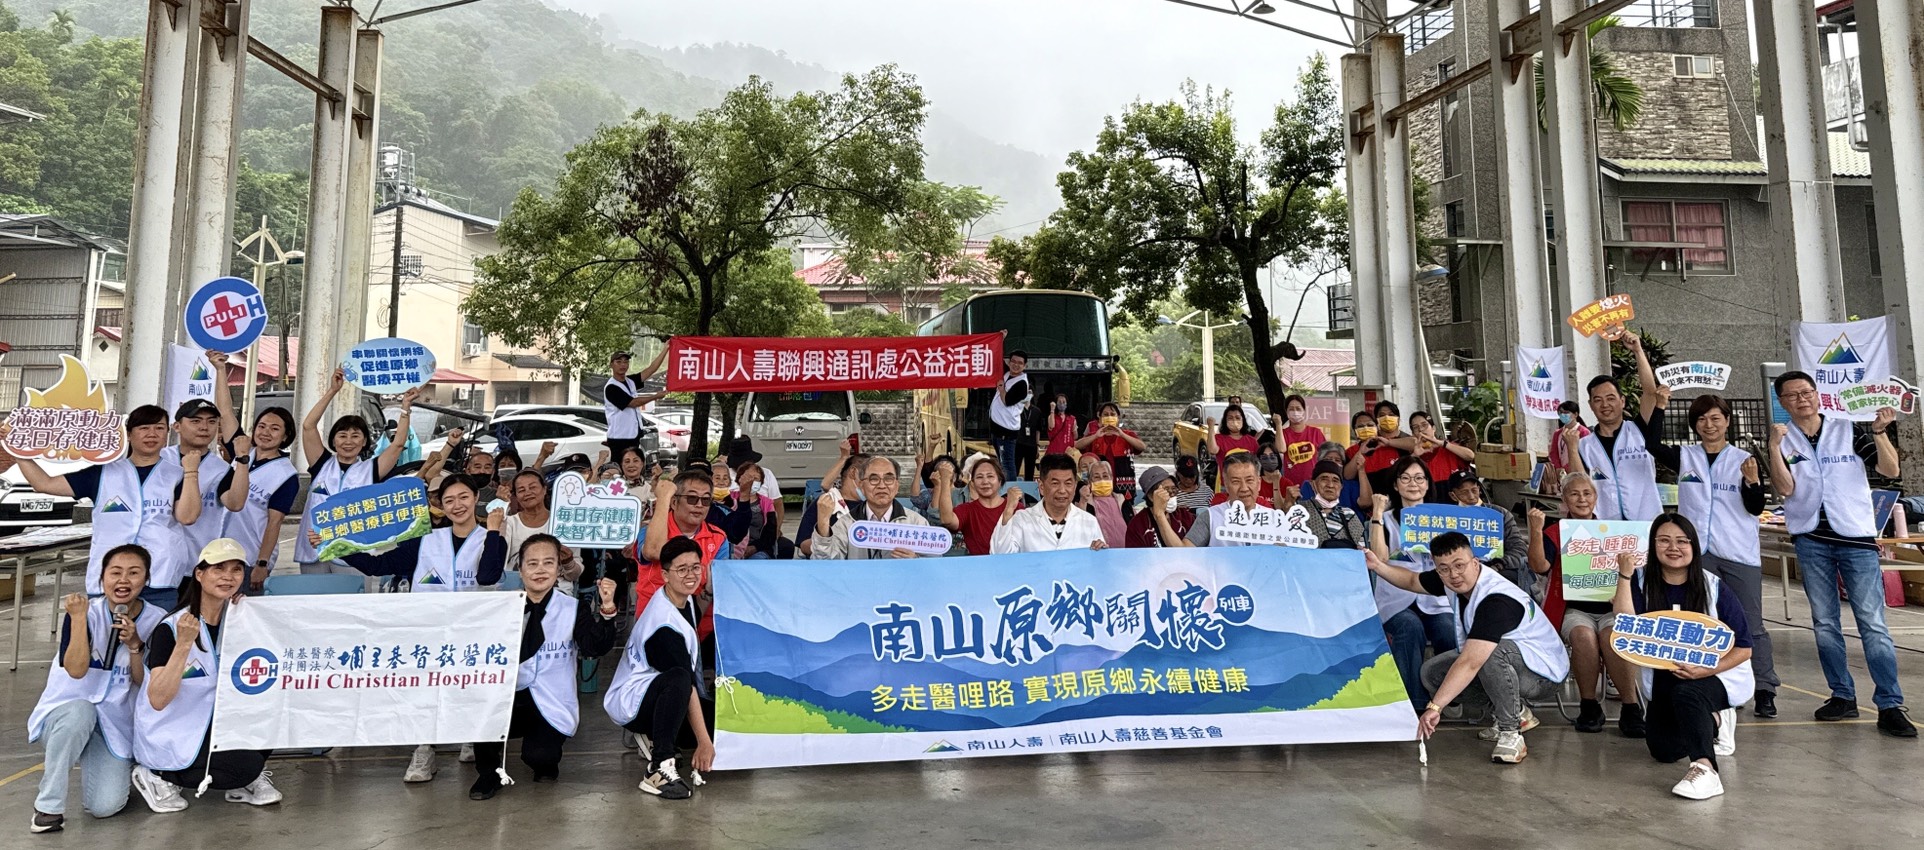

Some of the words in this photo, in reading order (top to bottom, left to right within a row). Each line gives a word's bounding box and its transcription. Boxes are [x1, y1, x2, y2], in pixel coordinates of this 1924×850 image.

[205, 306, 244, 327] PULI
[1582, 308, 1629, 334] 災害不再有
[352, 347, 424, 359] 串聯關懷網絡
[678, 344, 993, 381] 南山人壽聯興通訊處公益活動
[361, 359, 418, 372] 促進原鄉
[1660, 363, 1717, 379] 防災有南山
[362, 372, 421, 386] 醫療平權
[1815, 367, 1866, 384] 南山人壽
[1840, 384, 1902, 400] 常備滅火器
[1847, 396, 1900, 411] 居家好安心
[10, 408, 121, 429] 滿滿原動力
[8, 429, 120, 450] 每日存健康
[315, 487, 423, 524] 改善就醫可近性
[321, 504, 425, 540] 偏鄉醫療更便捷
[557, 507, 635, 524] 每日存健康
[1404, 513, 1500, 532] 改善就醫可近性
[555, 524, 633, 541] 失智不上身
[1404, 530, 1500, 549] 偏鄉便捷
[884, 537, 916, 546] Christian
[917, 540, 946, 549] Hospital
[1568, 539, 1600, 555] 多走
[1604, 535, 1637, 551] 睡飽
[1219, 594, 1252, 612] 列車
[871, 579, 1223, 664] 南山原鄉關懷
[1614, 614, 1732, 650] 滿滿原動力
[283, 646, 336, 660] 埔基醫療
[338, 643, 508, 671] 埔里基督教醫院
[1615, 638, 1718, 666] 今天我們最健康
[242, 668, 266, 676] PULI
[282, 661, 336, 672] 財團法人
[281, 674, 320, 689] Puli
[327, 672, 420, 689] Christian
[428, 669, 506, 689] Hospital
[871, 679, 1014, 712] 多走醫哩路
[1023, 667, 1251, 704] 實現原鄉永續健康
[967, 736, 1043, 751] 南山人壽
[1059, 725, 1223, 745] 南山人壽慈善基金會
